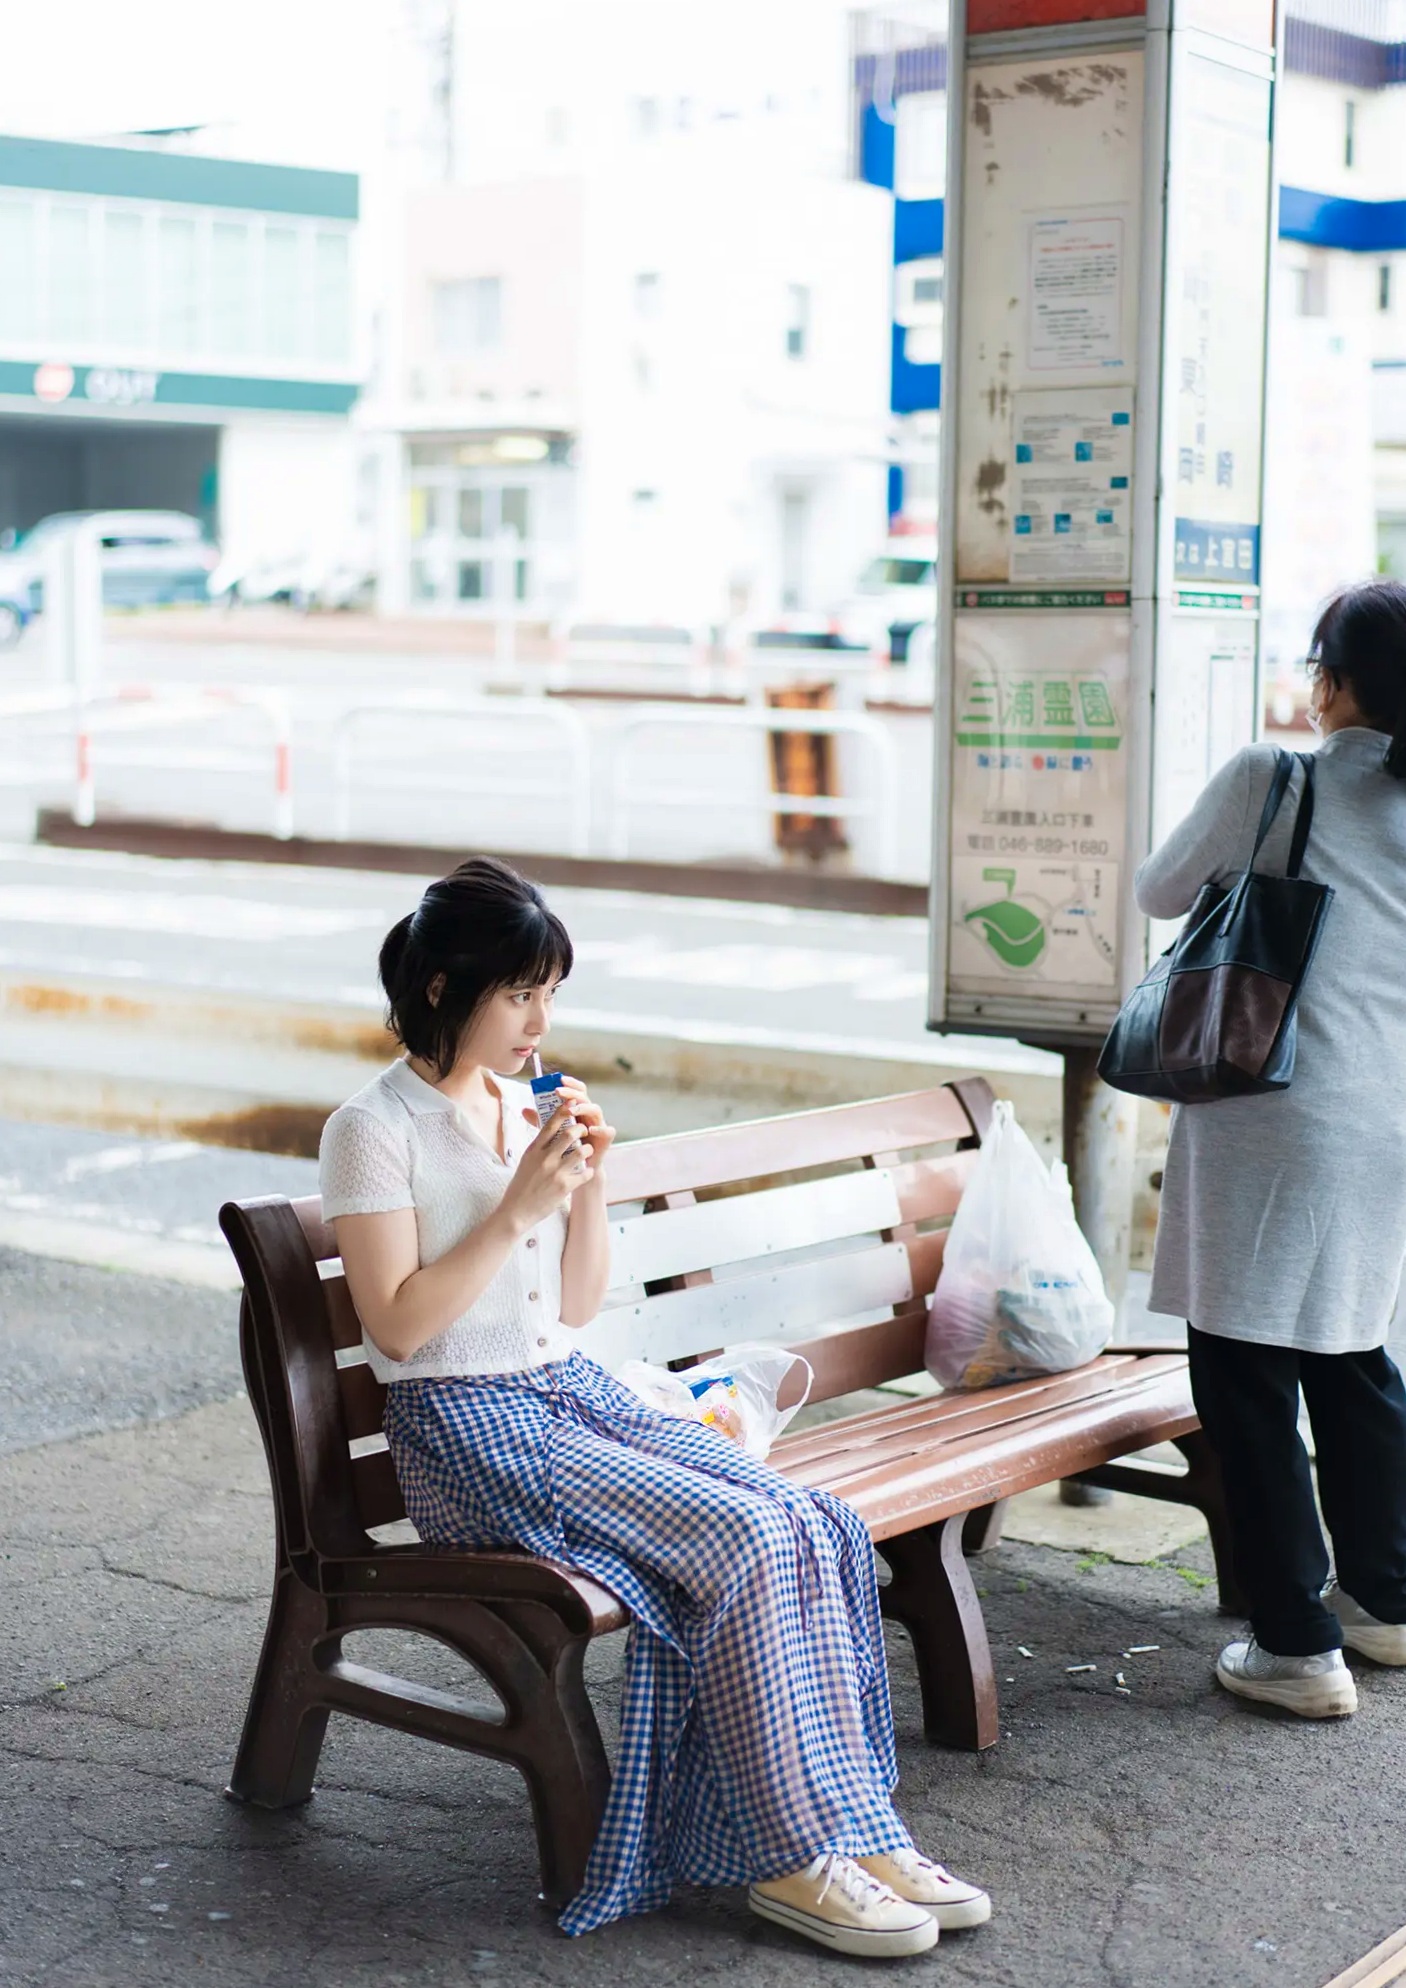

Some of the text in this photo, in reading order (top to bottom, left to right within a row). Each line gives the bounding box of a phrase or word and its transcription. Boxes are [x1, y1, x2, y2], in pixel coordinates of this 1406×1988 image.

[961, 679, 1116, 728] 三浦霊園
[999, 836, 1109, 857] 046-889-1680
